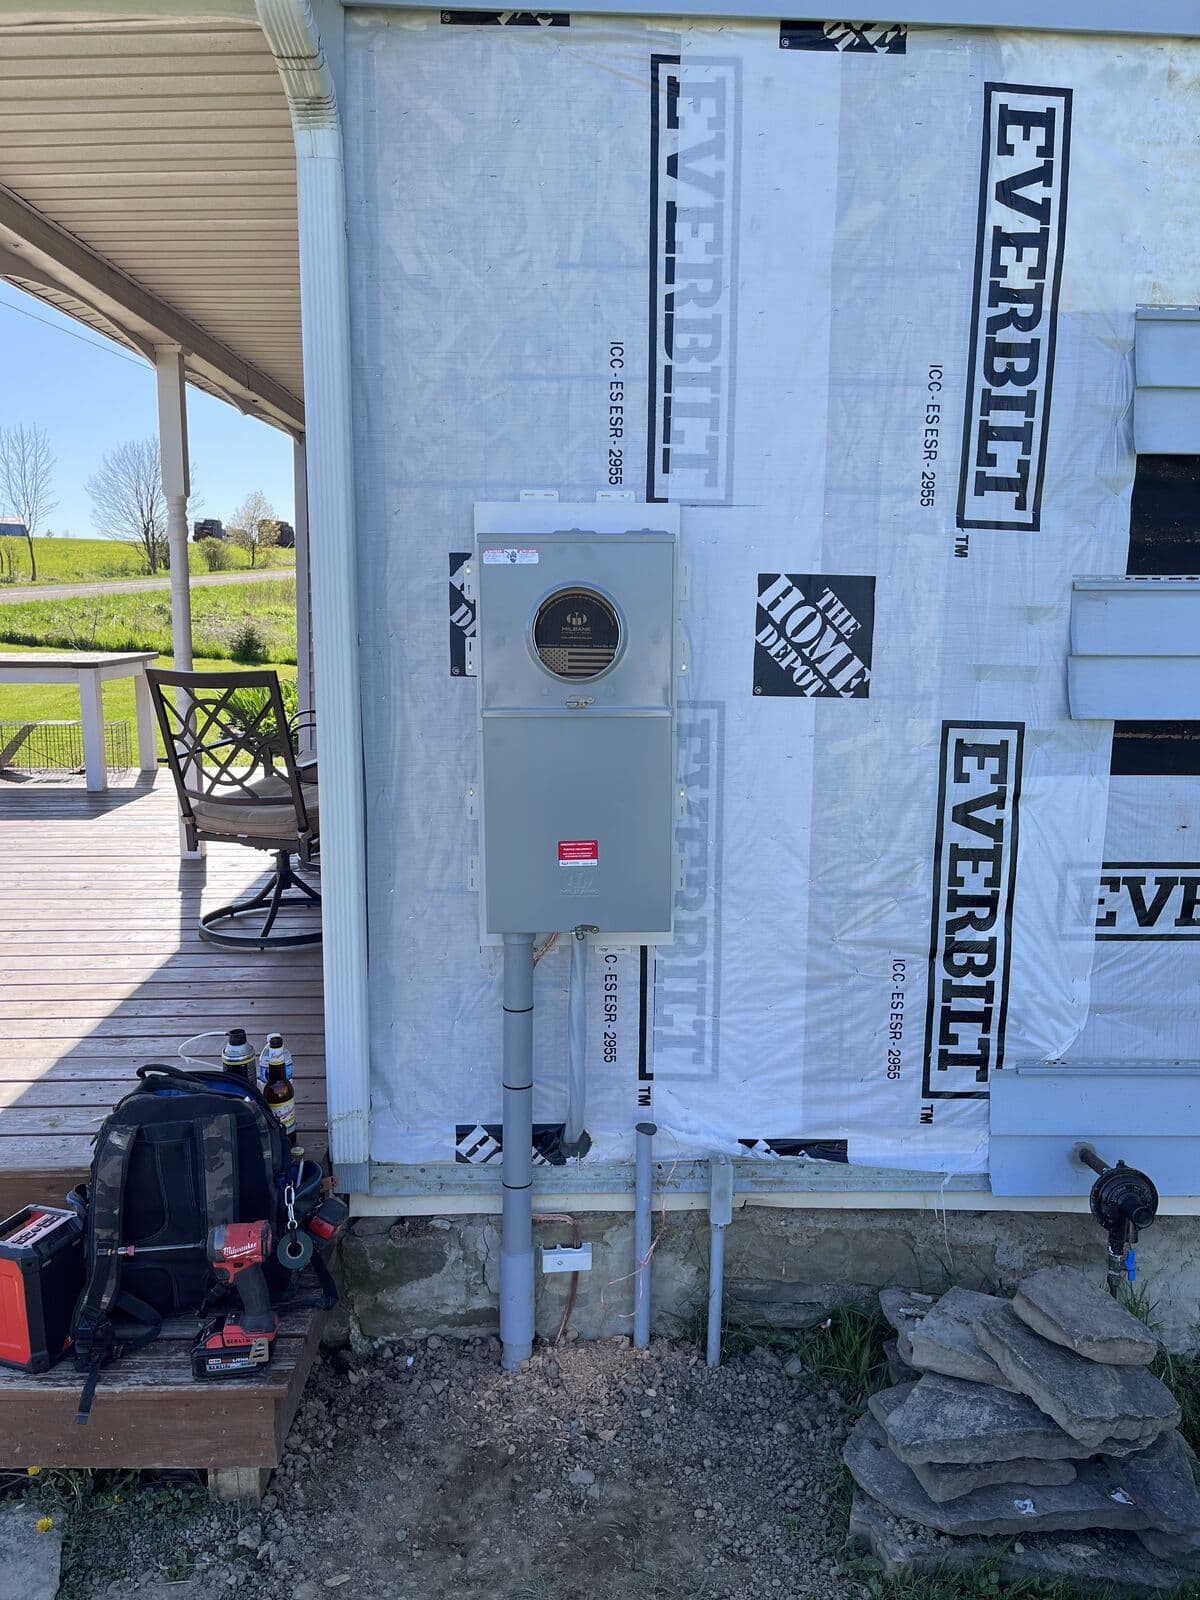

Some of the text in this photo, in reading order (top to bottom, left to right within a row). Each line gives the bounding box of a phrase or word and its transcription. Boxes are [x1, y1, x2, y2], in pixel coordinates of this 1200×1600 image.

[663, 76, 727, 488] EVERBILT
[973, 103, 1056, 511] EVERBILT
[954, 534, 969, 558] TM
[757, 574, 871, 698] HOME
[816, 587, 862, 640] THE
[755, 623, 827, 697] DEPOT
[937, 738, 1009, 1083] EVERBILT
[637, 1085, 651, 1106] TM
[919, 1104, 934, 1124] TM
